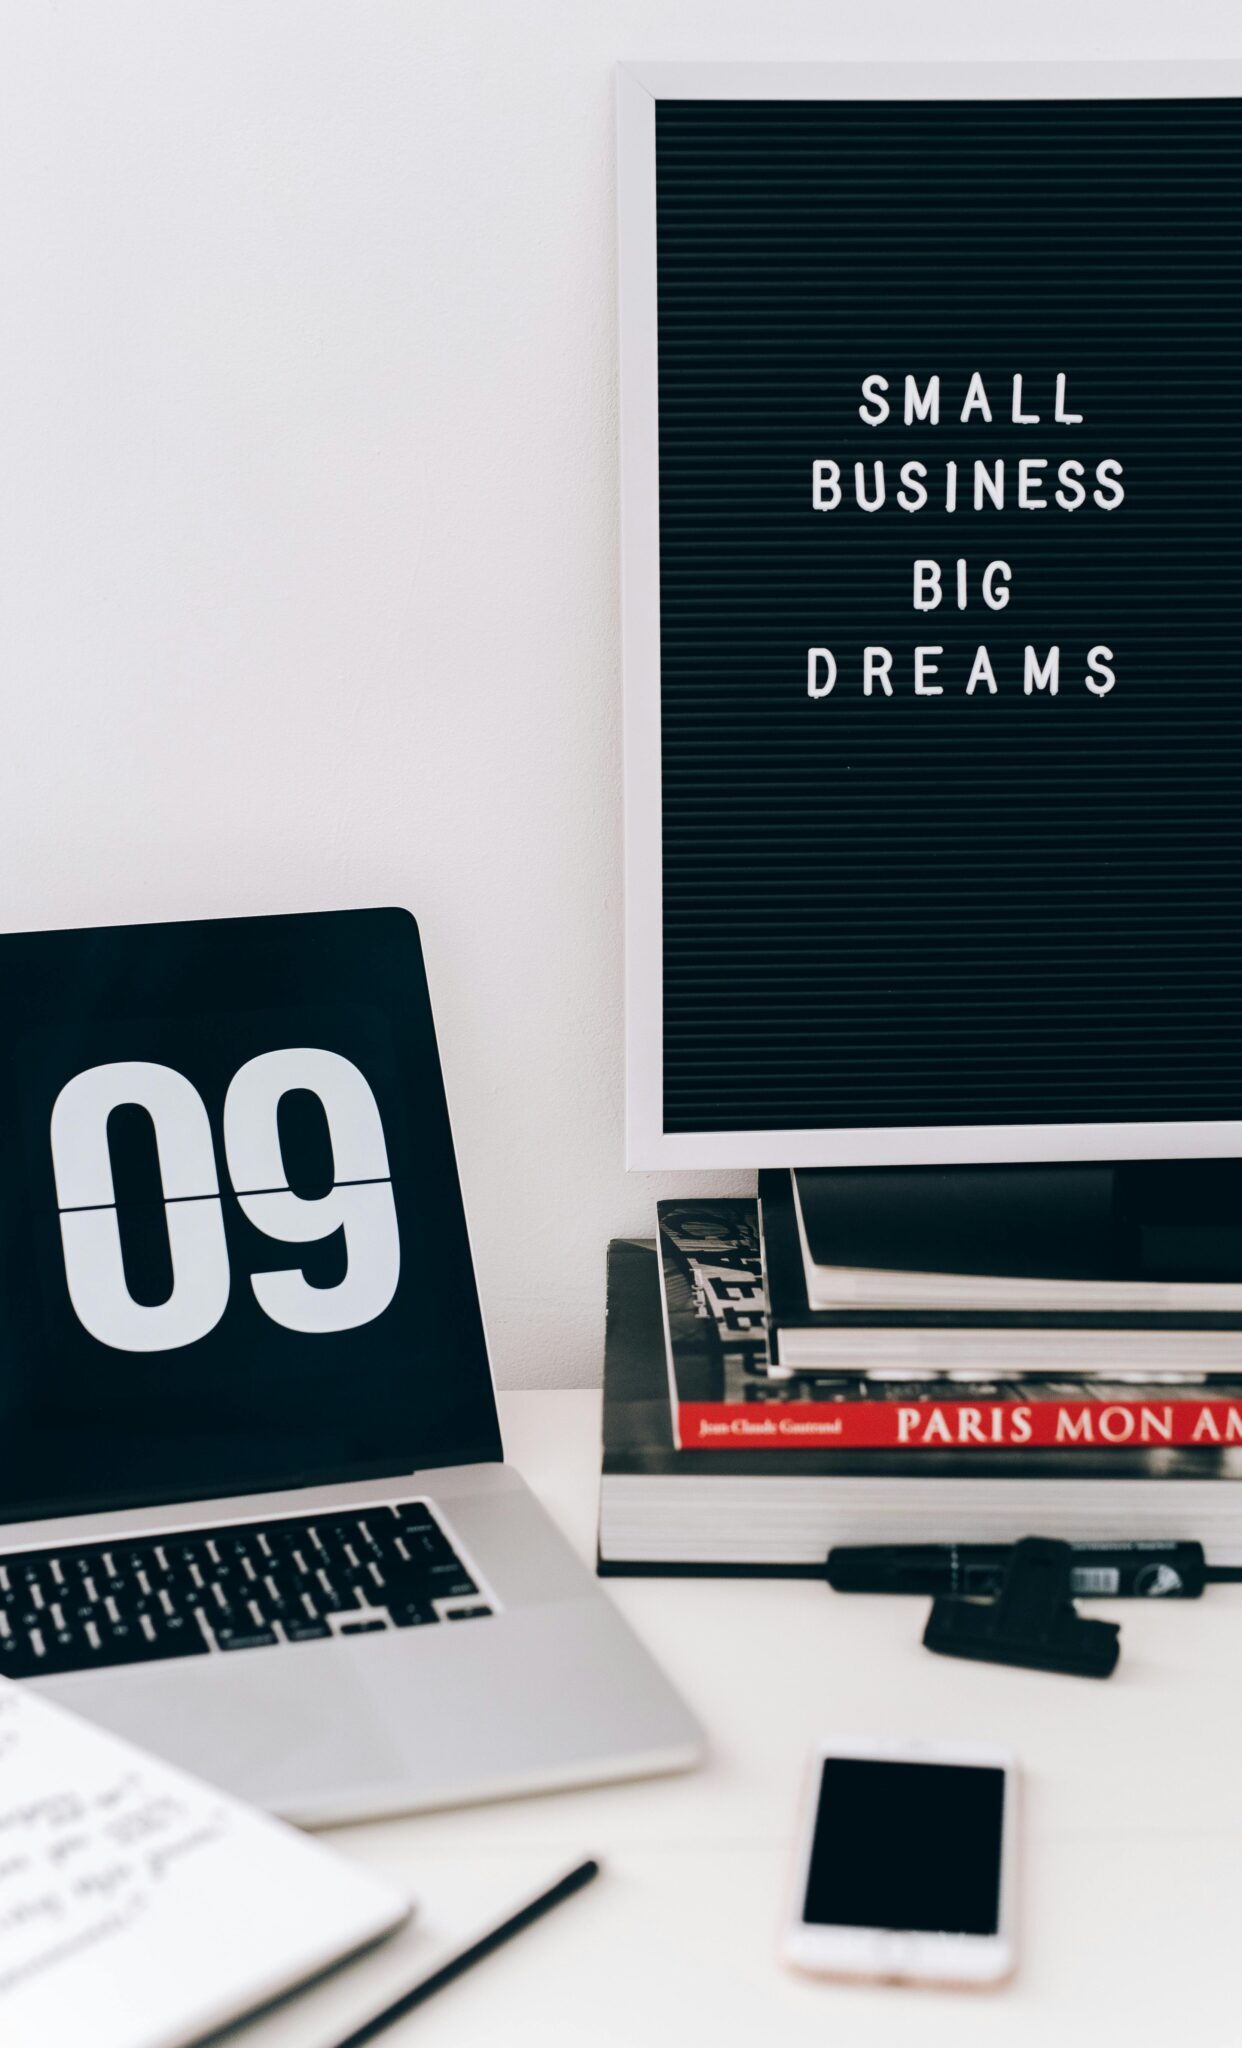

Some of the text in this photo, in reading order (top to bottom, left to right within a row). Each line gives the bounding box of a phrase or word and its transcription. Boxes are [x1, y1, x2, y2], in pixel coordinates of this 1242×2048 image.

[858, 371, 1084, 426] SMALL
[812, 458, 1126, 513] BUSINESS
[913, 558, 1012, 612] BIG
[807, 645, 1116, 699] DREAMS
[50, 1047, 401, 1353] 09
[897, 1405, 1033, 1443] PARIS
[1055, 1405, 1174, 1443] MON
